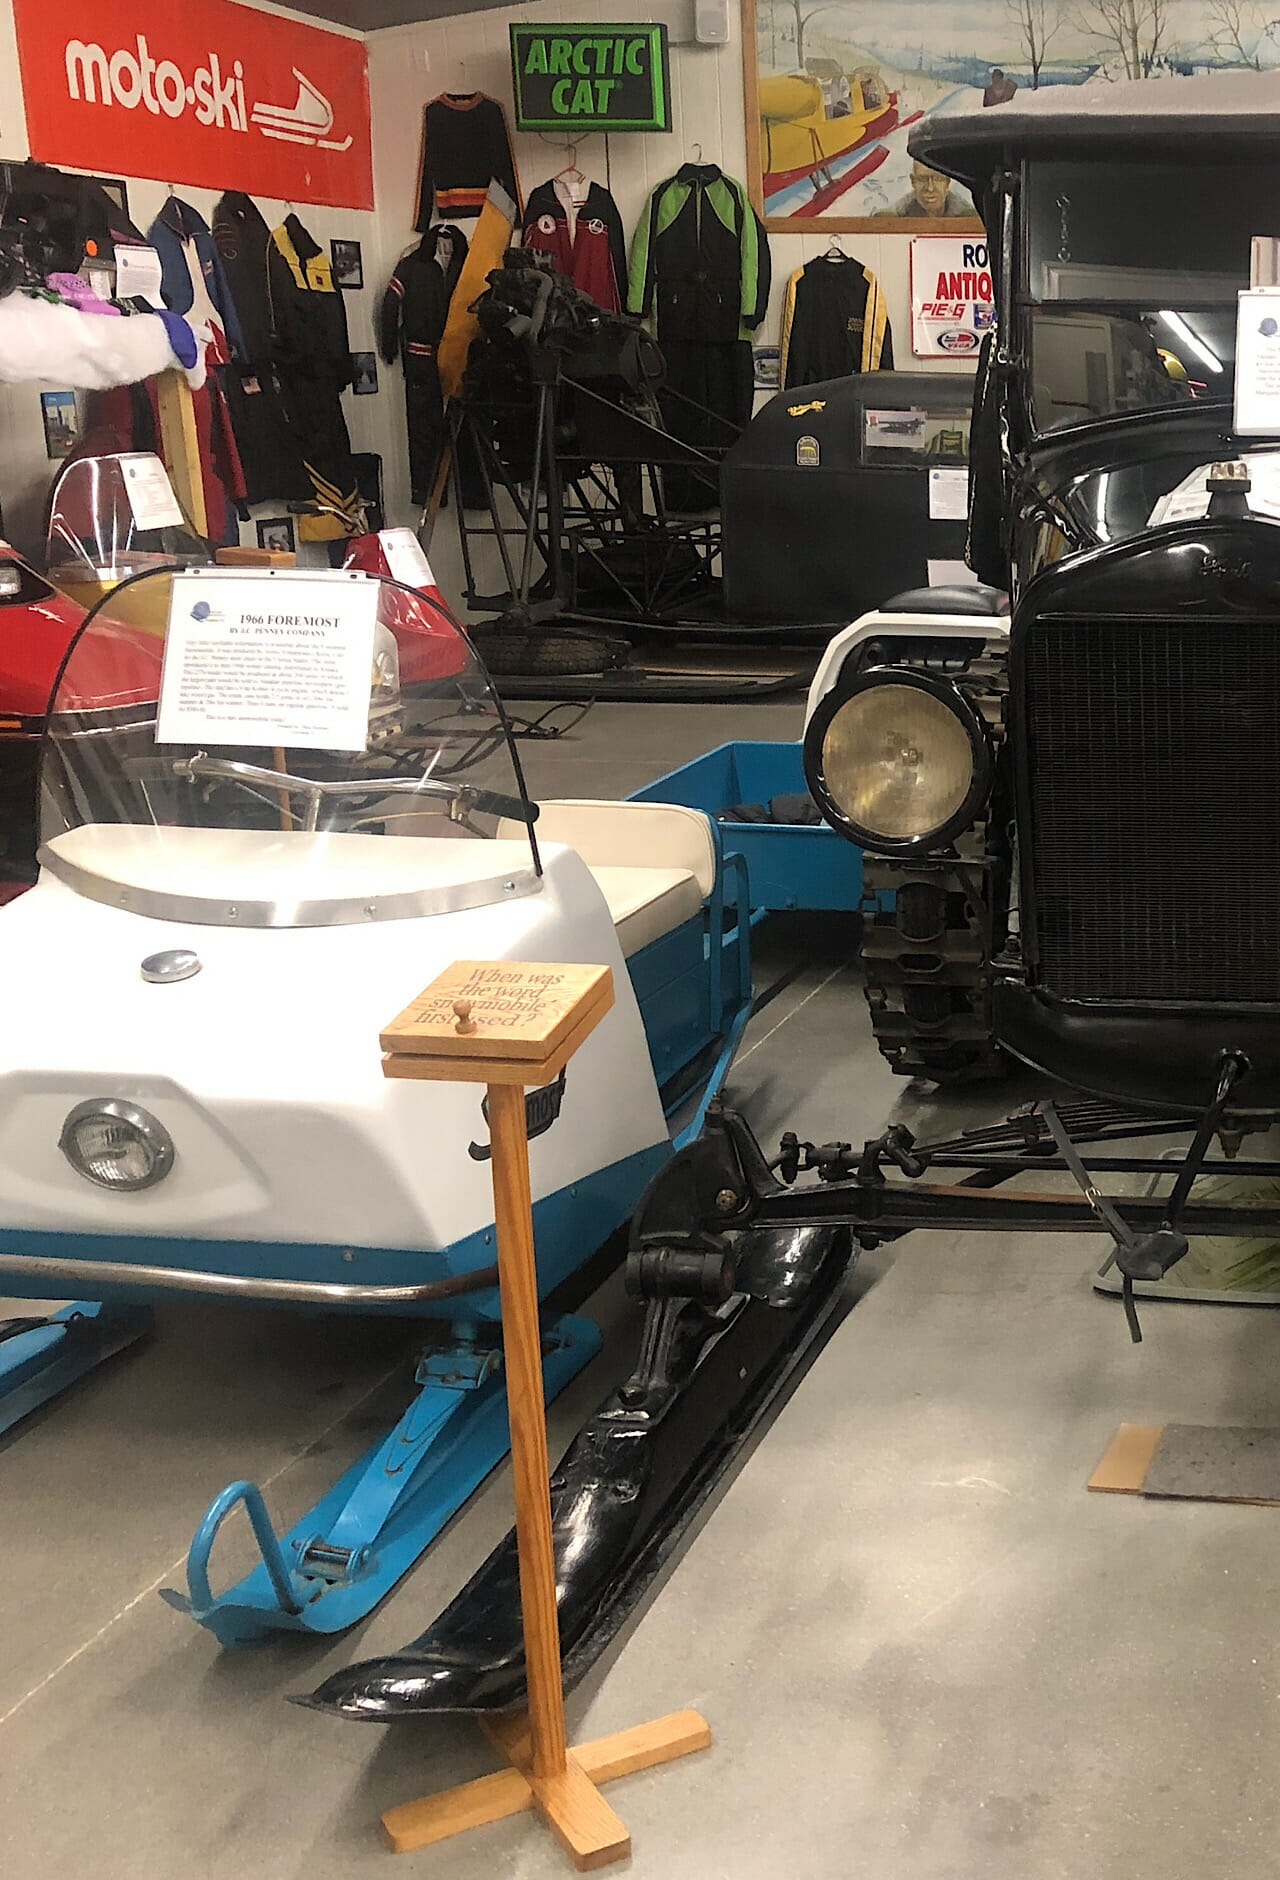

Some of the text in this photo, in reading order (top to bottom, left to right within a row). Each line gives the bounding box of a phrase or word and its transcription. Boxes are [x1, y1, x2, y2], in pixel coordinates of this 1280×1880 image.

[524, 38, 646, 75] ARCTIC
[551, 78, 615, 115] CAT
[240, 613, 264, 626] 1966
[267, 614, 341, 629] FOREMOST
[469, 968, 565, 985] When was
[458, 982, 548, 998] the word
